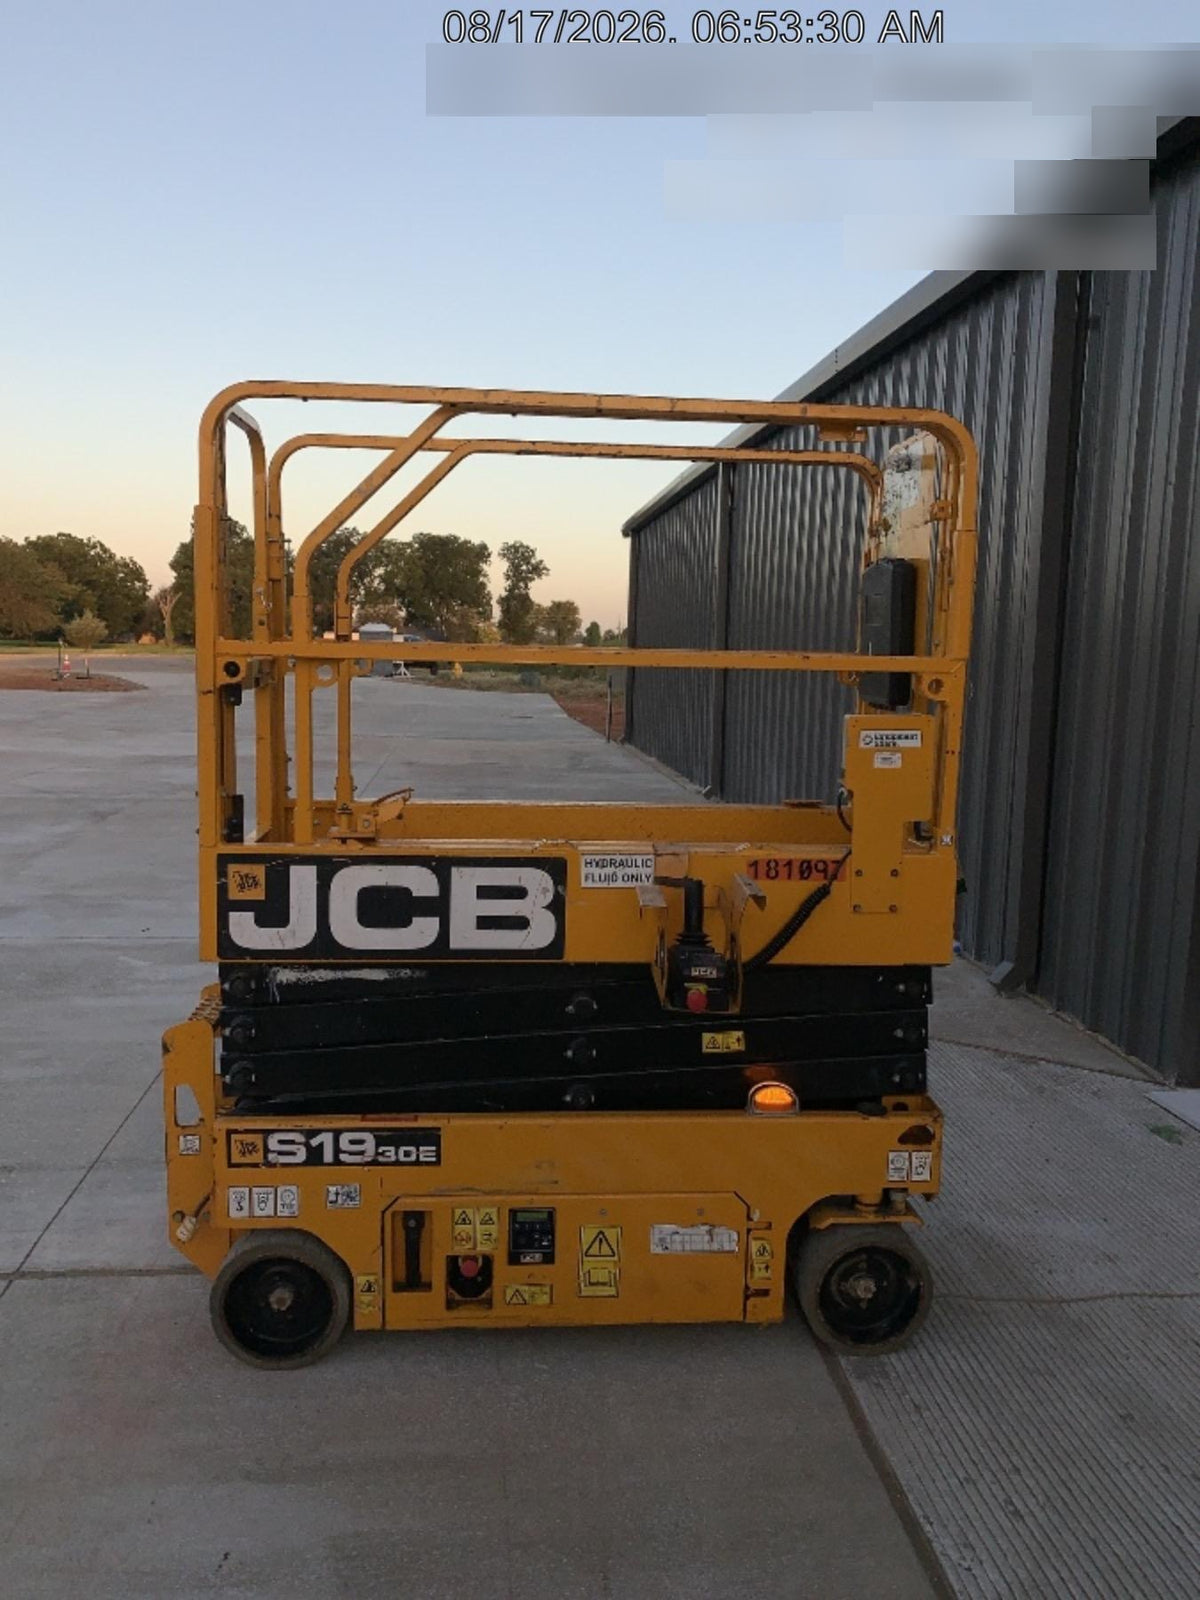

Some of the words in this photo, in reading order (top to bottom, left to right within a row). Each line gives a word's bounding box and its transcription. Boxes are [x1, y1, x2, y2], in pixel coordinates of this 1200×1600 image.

[584, 858, 653, 869] HYDRAULIC
[584, 872, 618, 885] FLUID
[622, 873, 652, 884] ONLY
[228, 864, 557, 951] JCB
